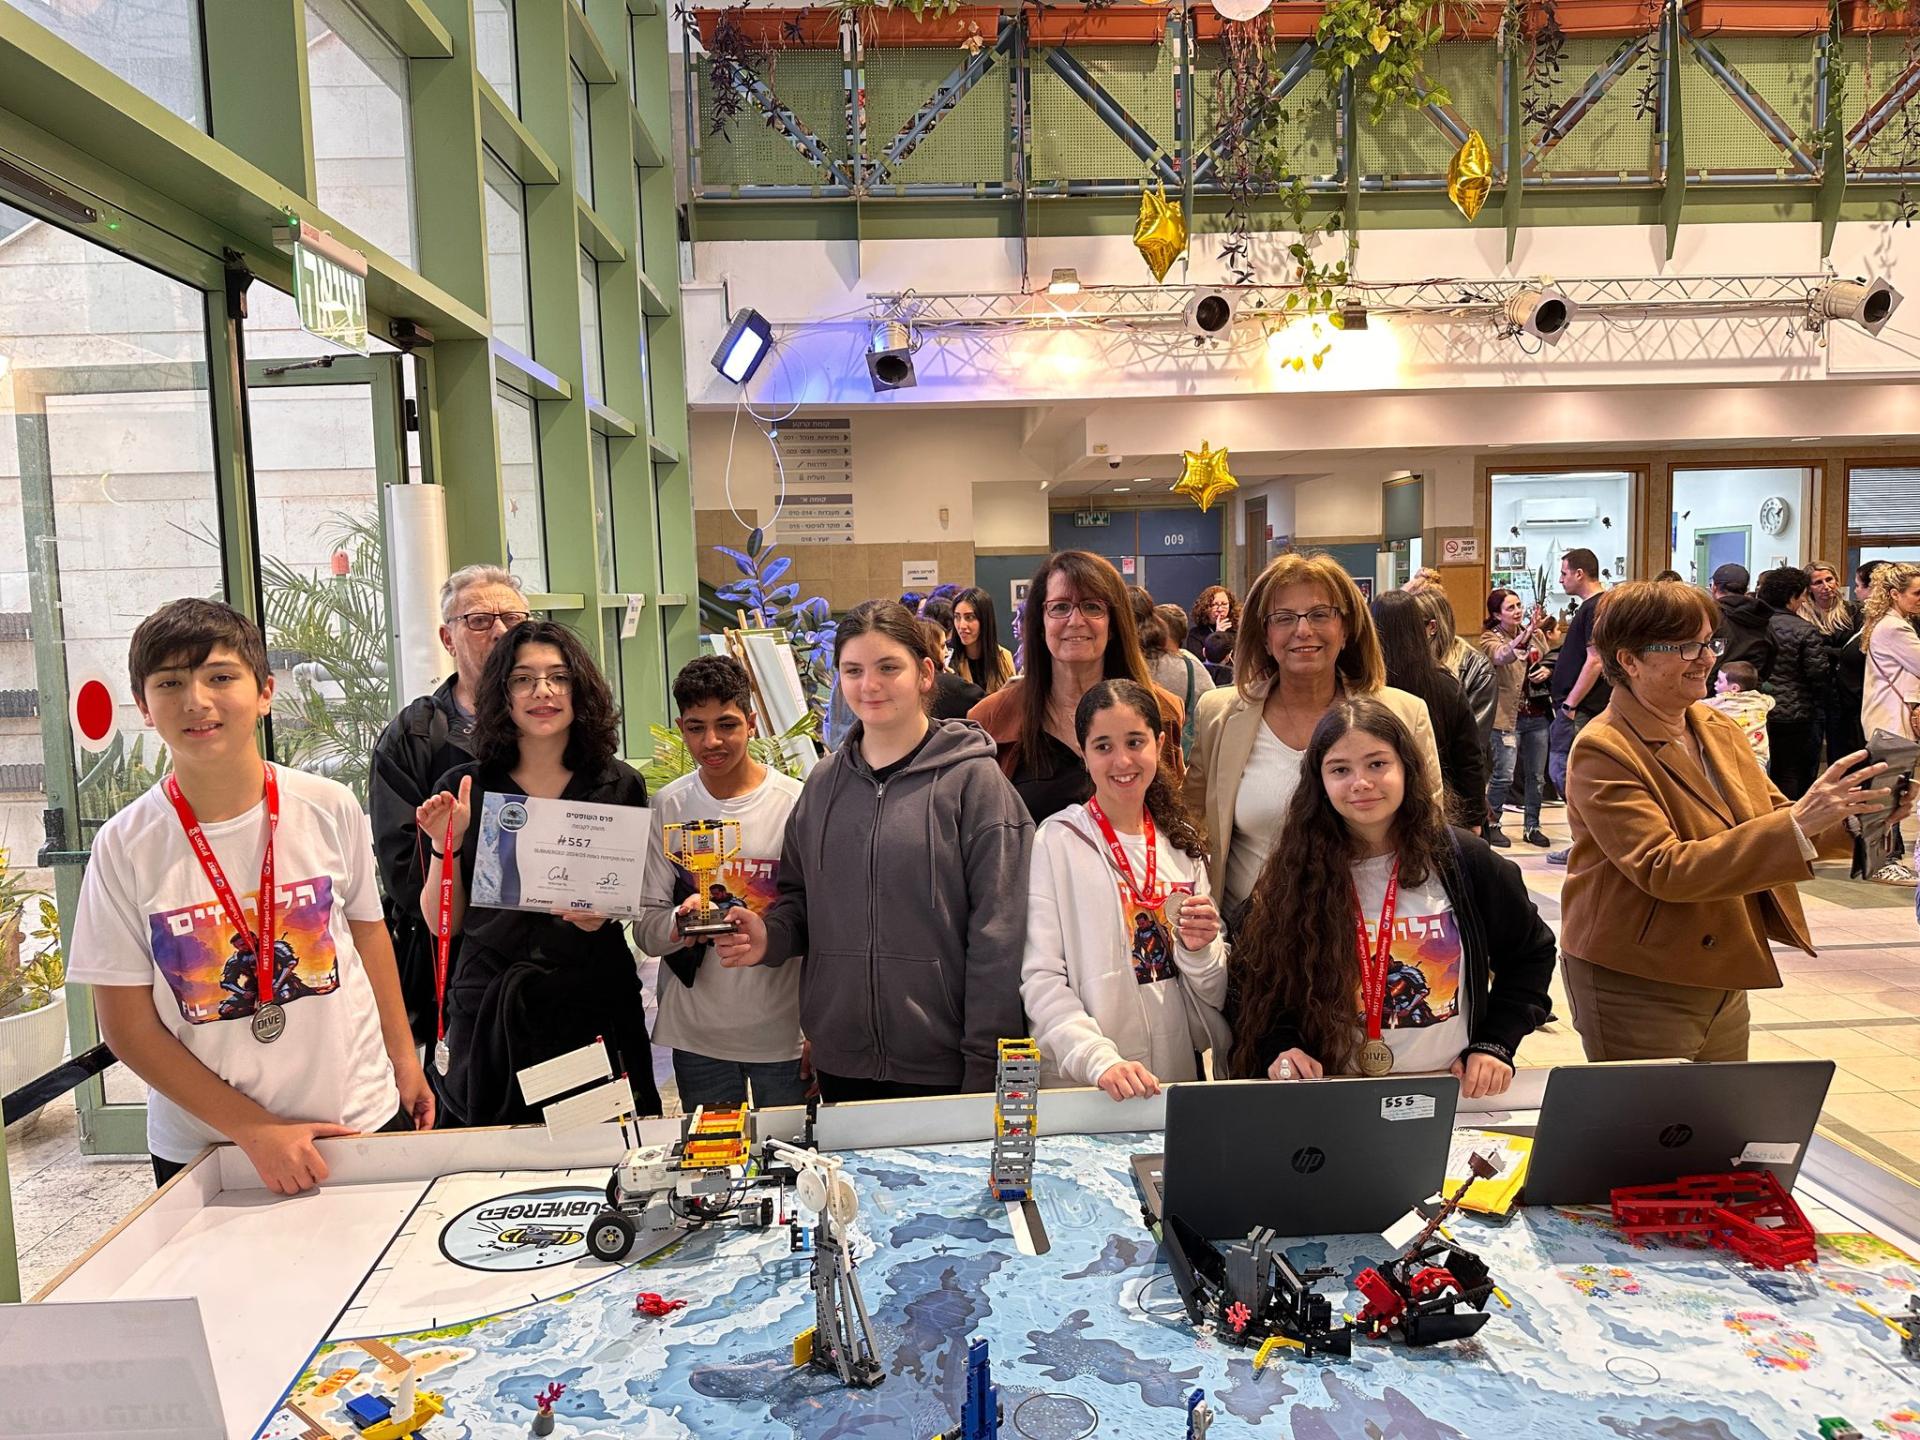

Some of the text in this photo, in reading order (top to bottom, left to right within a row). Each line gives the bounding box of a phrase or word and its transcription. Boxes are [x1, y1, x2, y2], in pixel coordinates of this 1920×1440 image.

[1077, 514, 1109, 525] יציאה
[1164, 534, 1184, 546] 009
[600, 815, 613, 823] פרס
[557, 834, 591, 848] #557
[570, 901, 592, 909] DIVE
[1384, 905, 1392, 920] FIRST
[1379, 937, 1387, 961] Challenge
[257, 1013, 280, 1030] DIVE
[1361, 1052, 1387, 1062] DIVE
[1663, 1123, 1691, 1148] hp
[1295, 1147, 1322, 1174] hp
[476, 1201, 612, 1221] SUBMERGED
